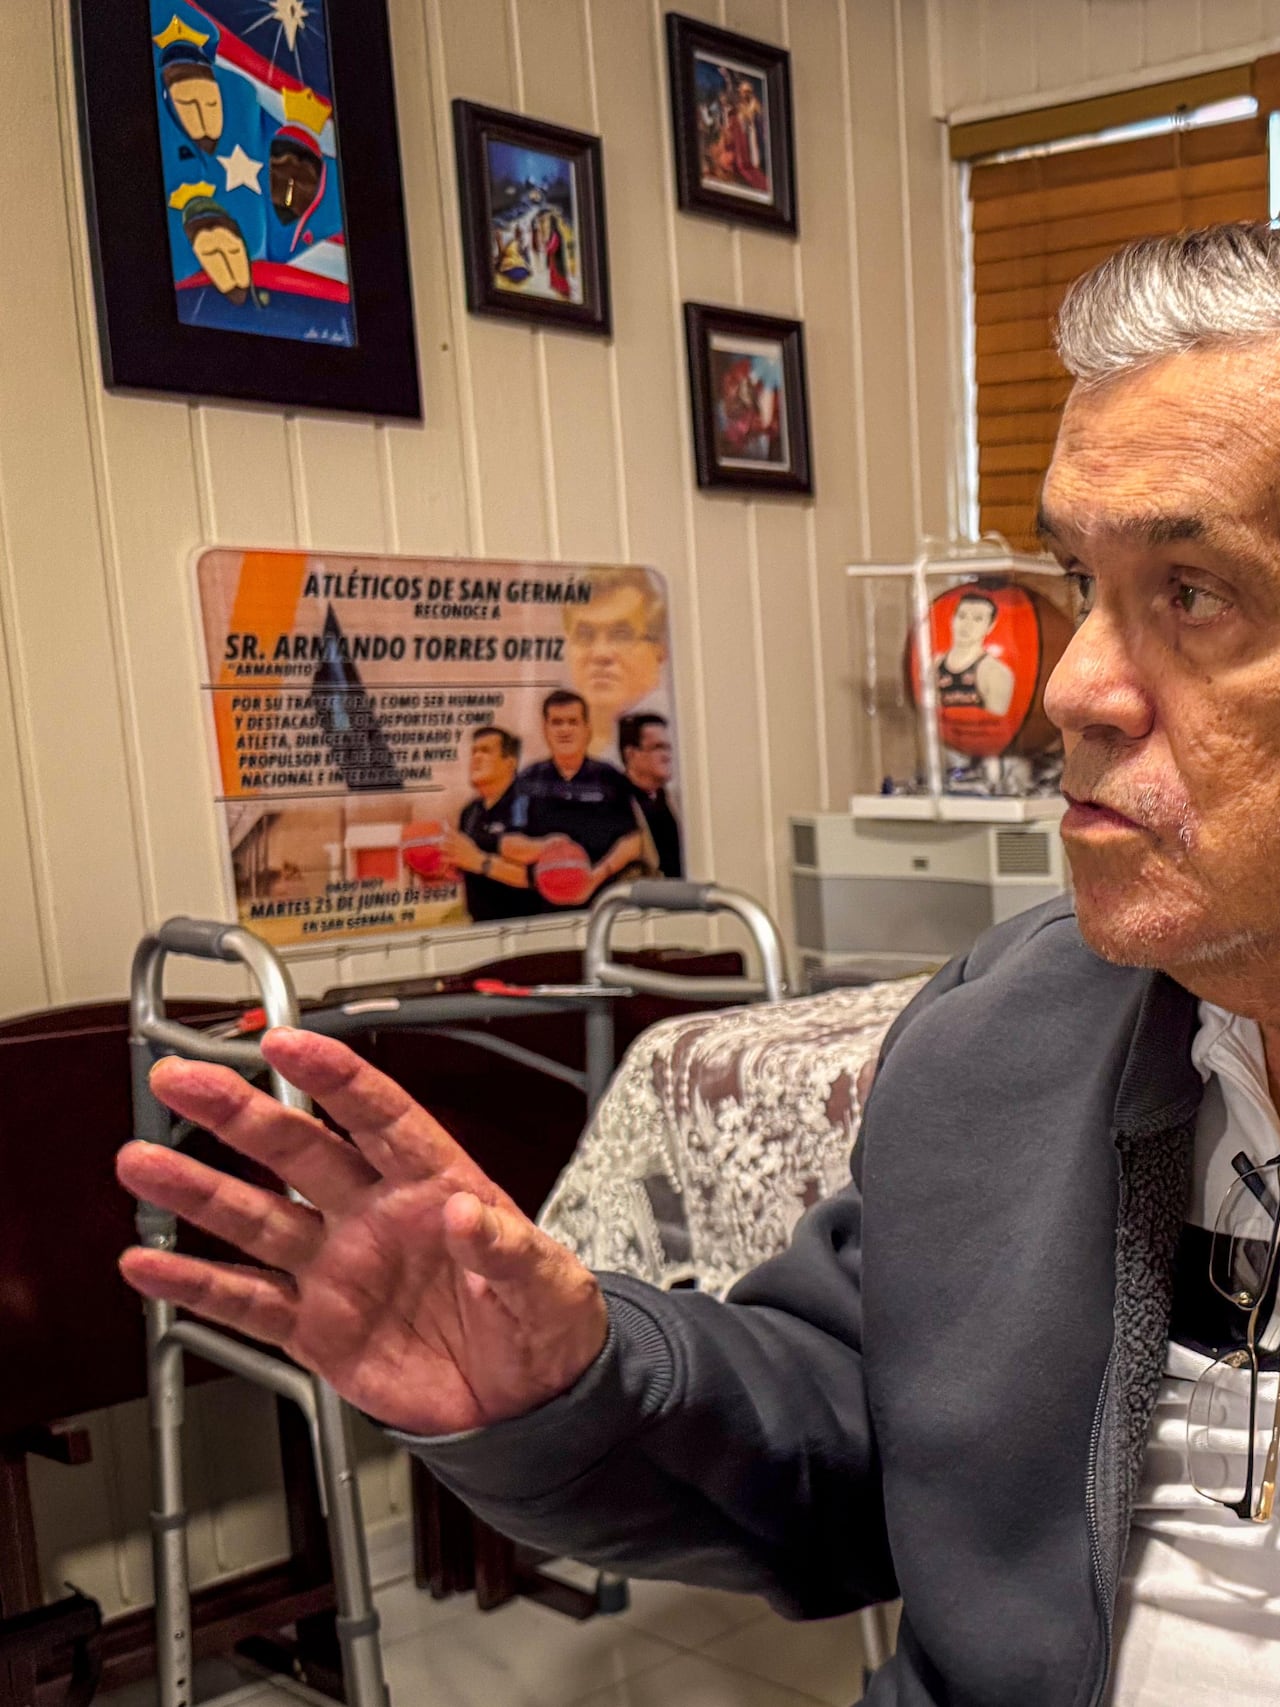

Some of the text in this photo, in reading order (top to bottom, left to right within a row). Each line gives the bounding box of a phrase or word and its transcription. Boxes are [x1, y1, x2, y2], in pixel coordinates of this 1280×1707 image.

[304, 569, 592, 603] ATLÉTICOS DE SAN GERMÁN
[415, 604, 502, 619] RECONOCE A
[225, 635, 565, 662] SR. ARMANDO TORRES ORTIZ
[233, 696, 261, 711] POR
[265, 696, 281, 711] SU
[381, 695, 419, 709] COMO
[448, 692, 504, 707] HUMANO
[236, 717, 243, 731] Y
[457, 711, 494, 725] COMO
[239, 752, 321, 768] PROPULSOR
[412, 750, 420, 762] A
[423, 748, 457, 761] NIVEL
[242, 770, 314, 787] NACIONAL
[318, 771, 325, 784] E
[251, 900, 311, 917] MARTES
[337, 895, 353, 912] DE
[357, 890, 400, 914] JUNIO
